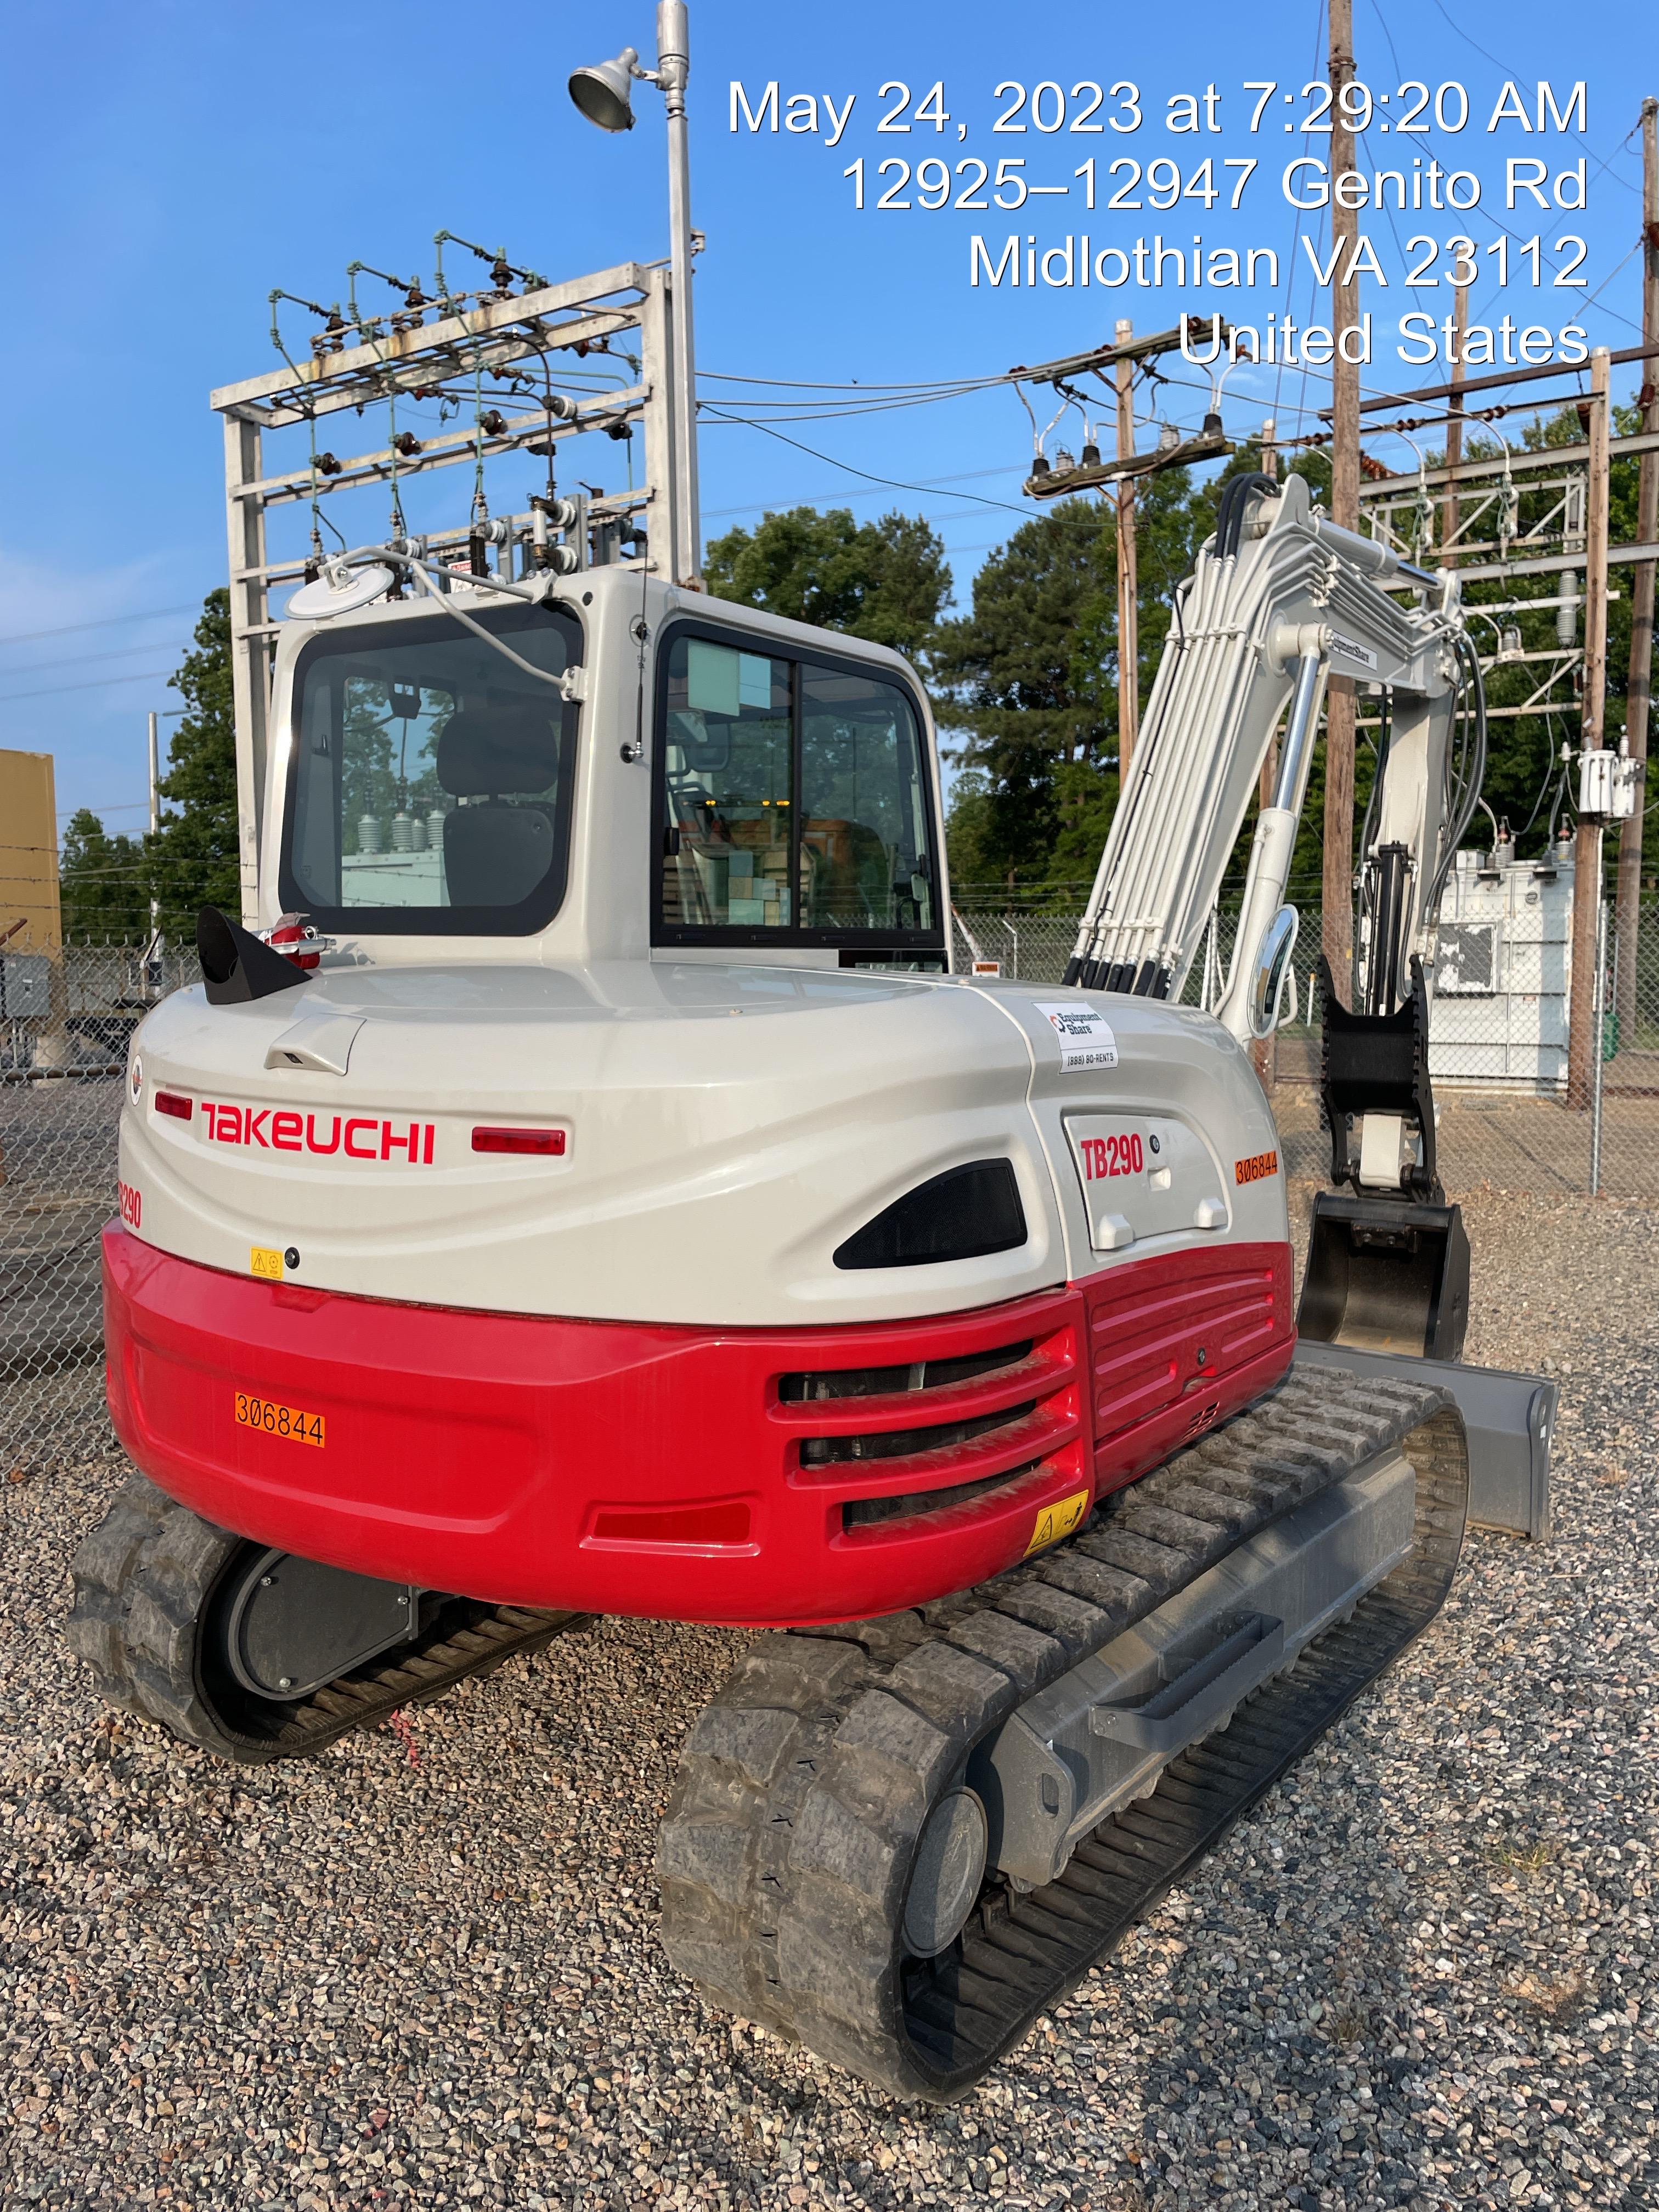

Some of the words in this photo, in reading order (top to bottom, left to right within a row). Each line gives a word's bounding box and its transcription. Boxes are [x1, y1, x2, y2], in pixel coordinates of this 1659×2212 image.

[1057, 1012, 1102, 1024] Equipment
[1066, 1024, 1092, 1035] Share
[1067, 1054, 1085, 1066] (888)
[1086, 1052, 1114, 1064] 80-RENTS
[1080, 1133, 1143, 1181] TB290
[1236, 1150, 1277, 1184] 306844
[119, 1180, 141, 1228] B290
[237, 1395, 323, 1444] 306844
